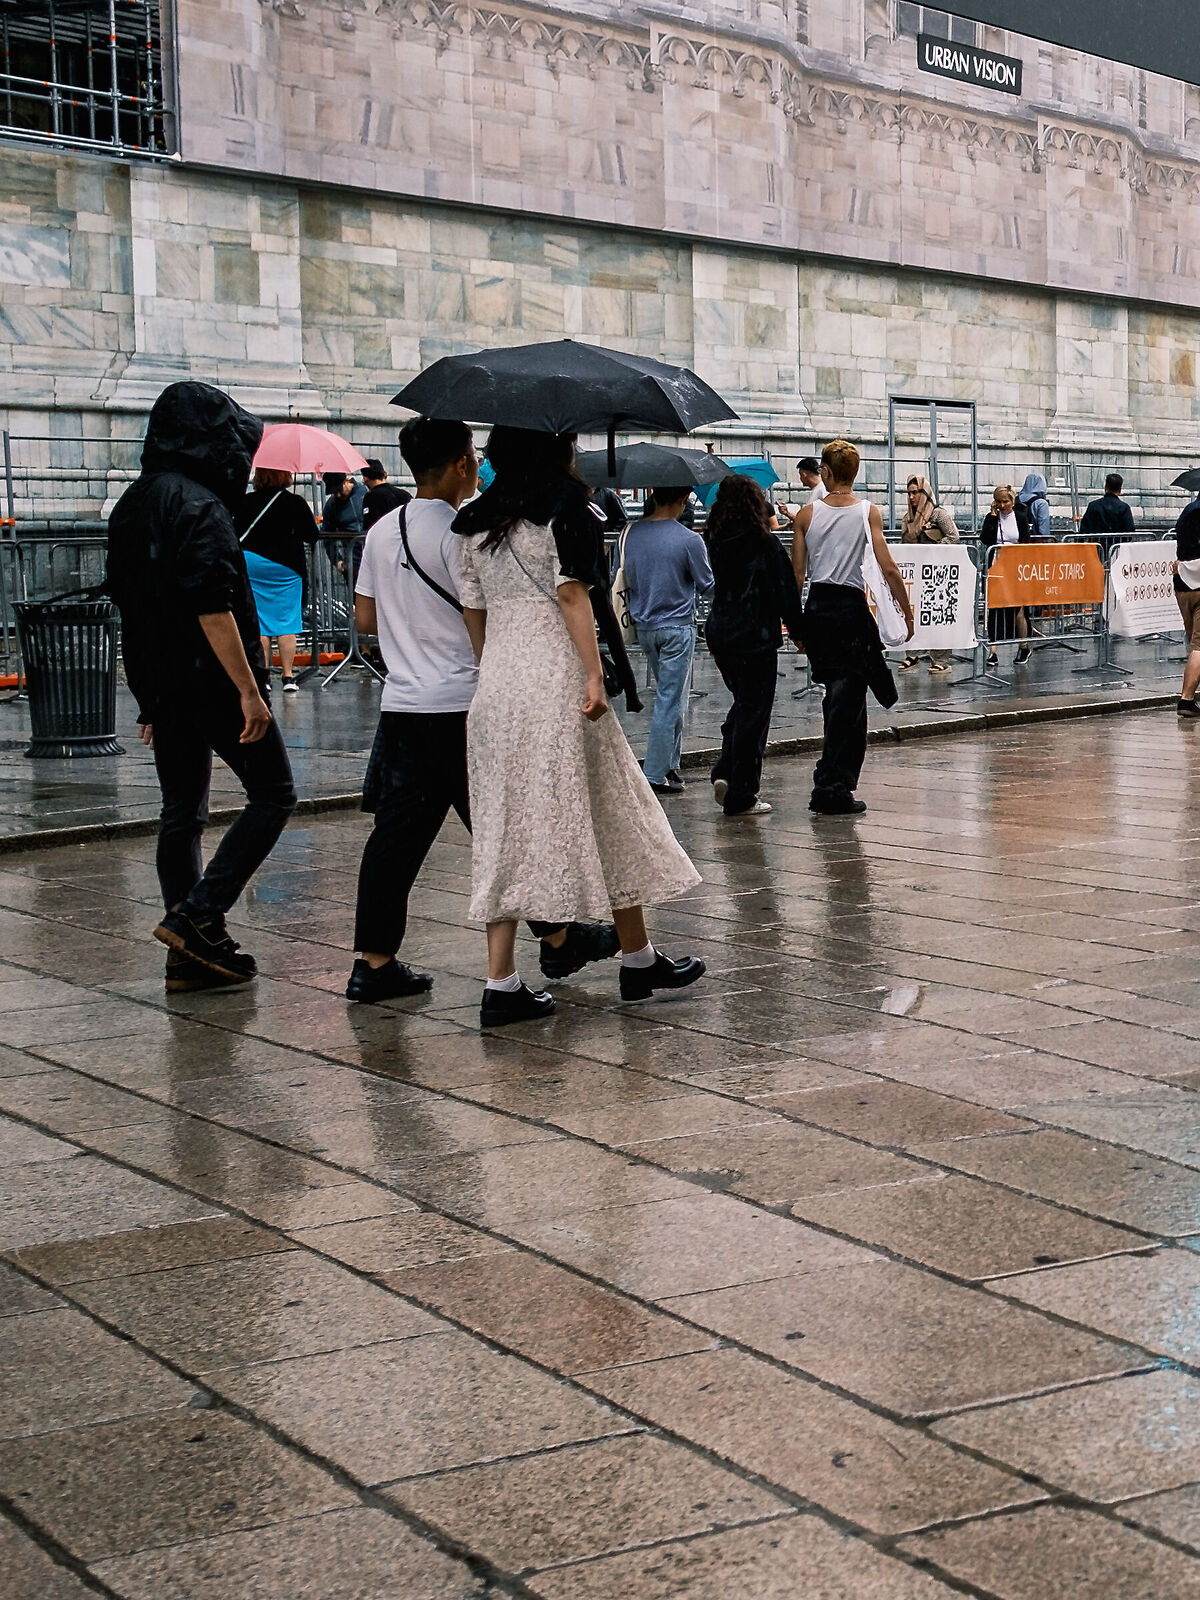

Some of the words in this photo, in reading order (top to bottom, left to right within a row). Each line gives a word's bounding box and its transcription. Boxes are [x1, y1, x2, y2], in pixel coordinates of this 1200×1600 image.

[925, 43, 970, 75] URBAN
[973, 56, 1017, 87] VISION
[901, 569, 914, 579] UR
[1018, 564, 1050, 581] SCALE
[1059, 563, 1085, 580] STAIRS
[1045, 586, 1058, 595] GATE
